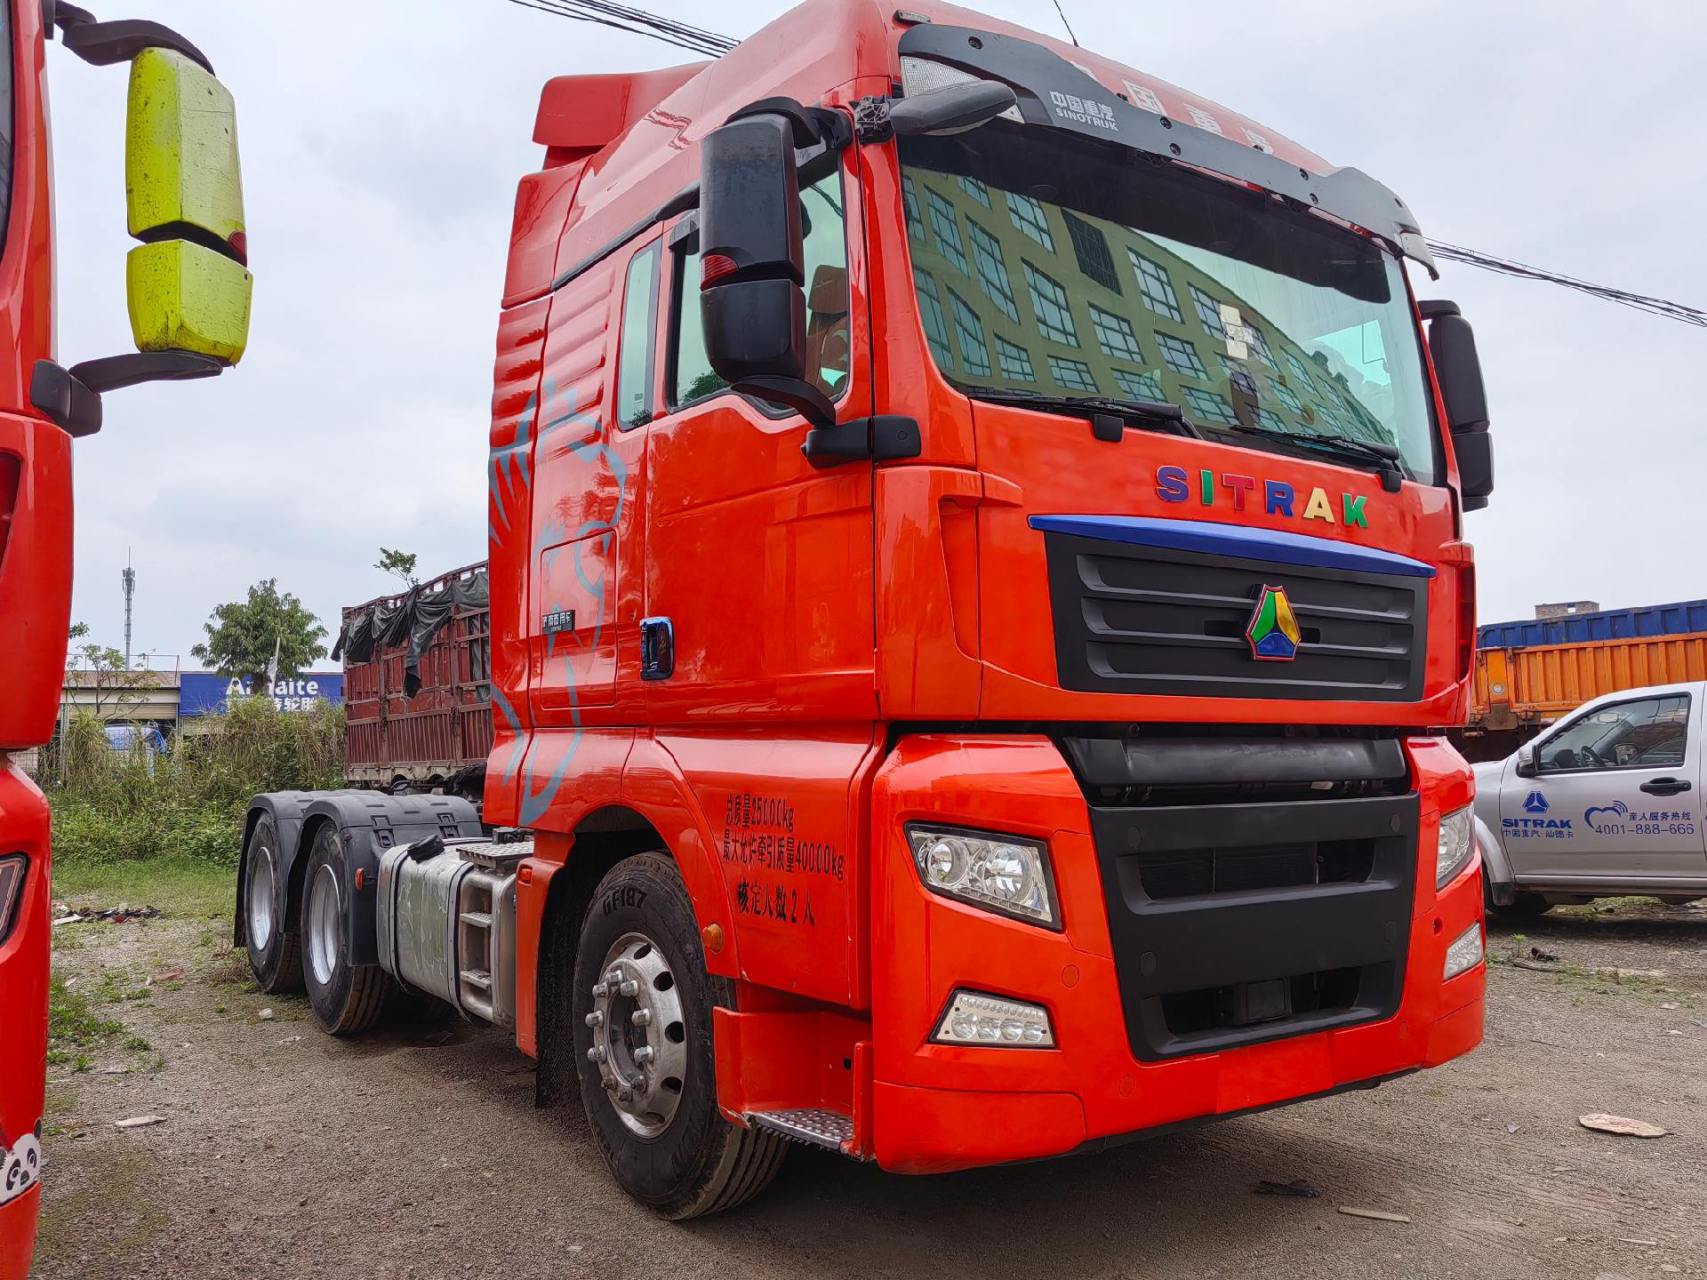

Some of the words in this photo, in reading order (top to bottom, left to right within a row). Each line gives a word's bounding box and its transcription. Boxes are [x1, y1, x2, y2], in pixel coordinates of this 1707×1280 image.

[1049, 90, 1116, 122] 中国重汽
[1055, 107, 1119, 132] SINOTRUK
[1155, 465, 1369, 528] SITRAK
[1502, 818, 1572, 829] SITRAK
